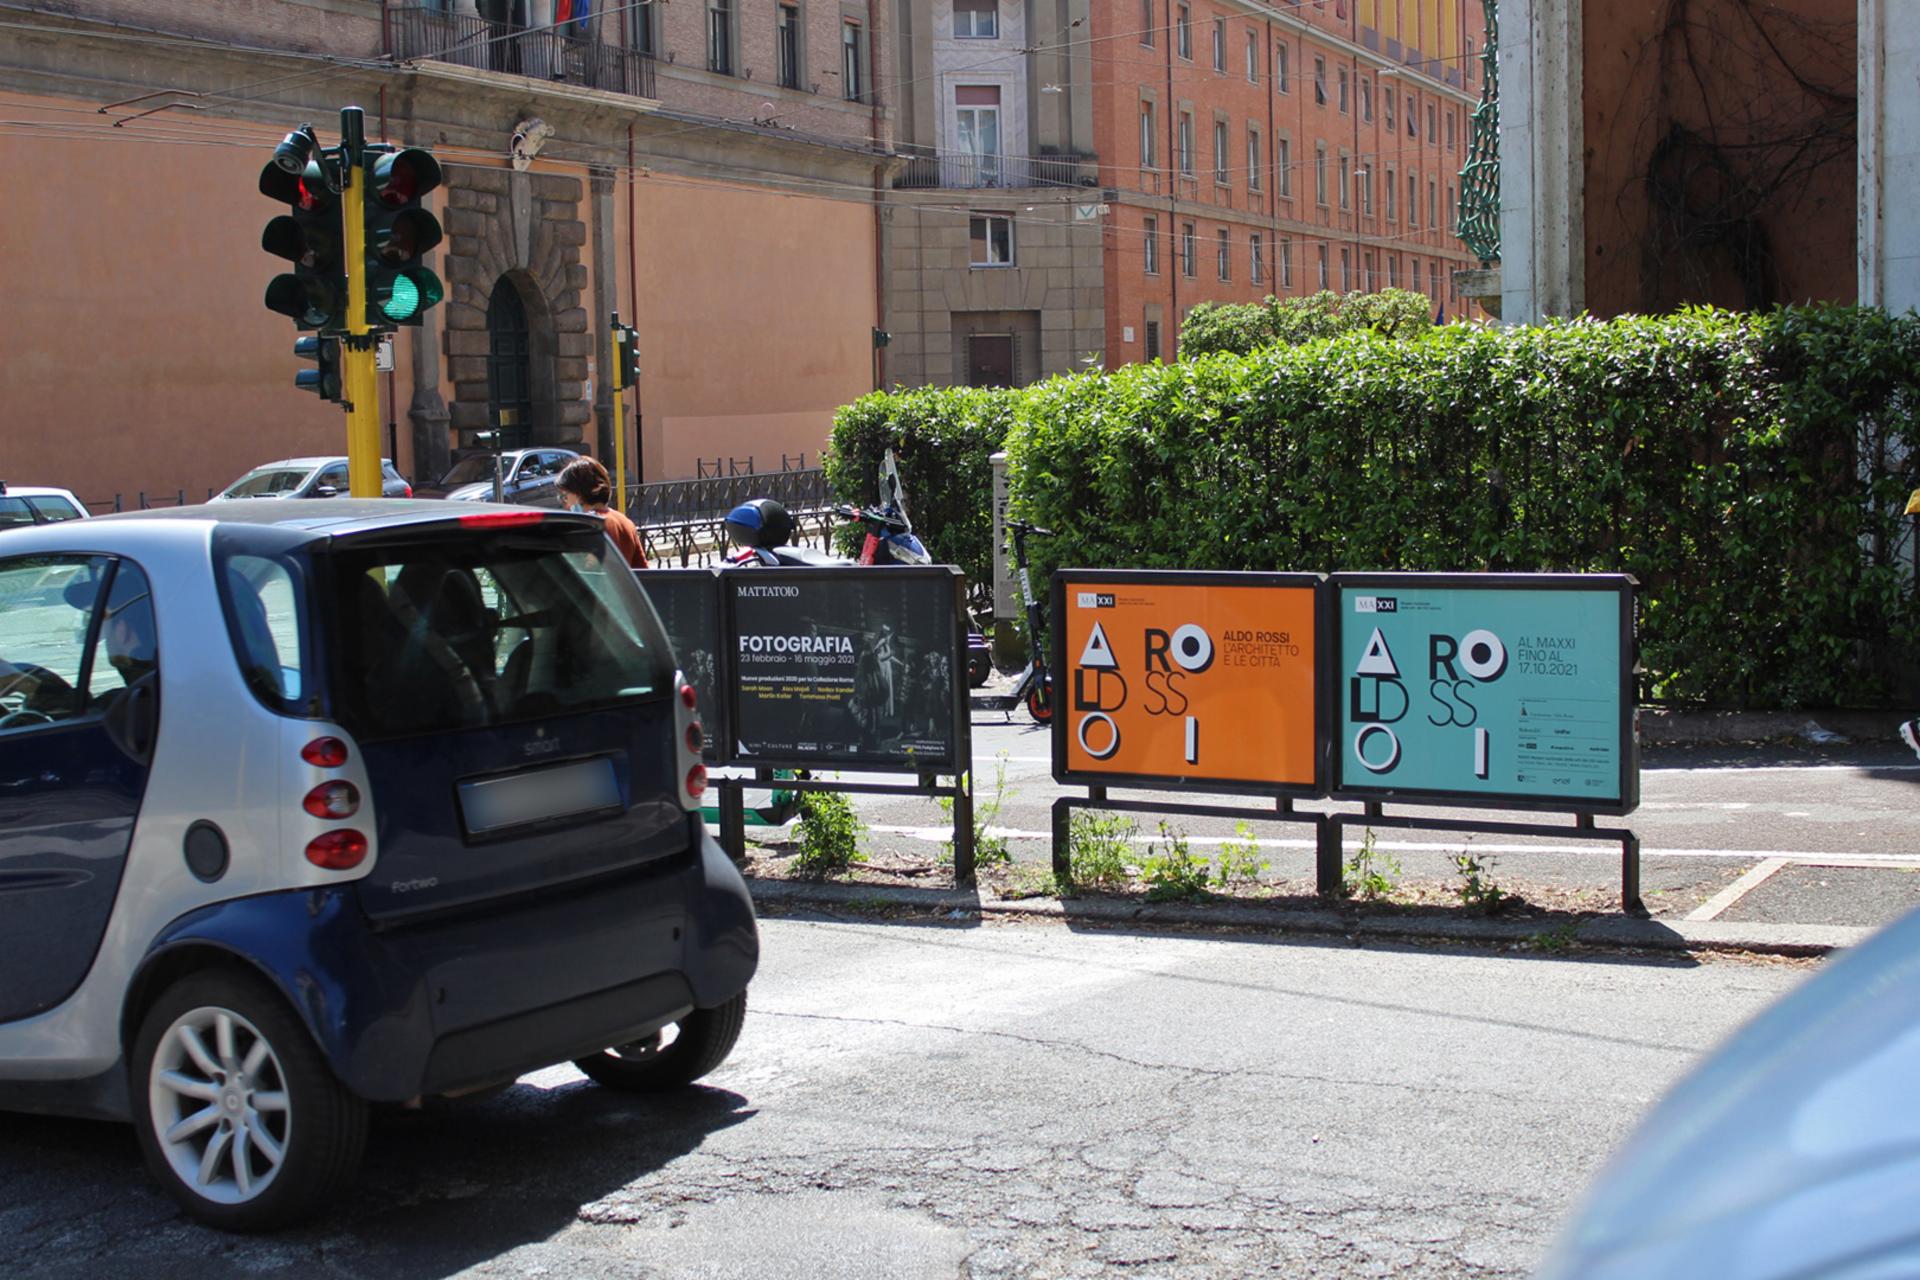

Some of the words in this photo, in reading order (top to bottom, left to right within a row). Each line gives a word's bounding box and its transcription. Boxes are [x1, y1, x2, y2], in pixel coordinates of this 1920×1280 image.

[738, 586, 799, 597] MATTATOIO
[1080, 595, 1114, 606] MAXXI
[1358, 599, 1395, 610] MAXXI
[1223, 630, 1253, 642] ALDO
[1256, 631, 1290, 643] ROSSI
[1518, 636, 1533, 648] AL
[1536, 637, 1576, 649] MAXXI
[739, 635, 854, 653] FOTOGRAFIA
[740, 654, 751, 663] 23
[752, 654, 787, 663] febbraio
[795, 654, 803, 663] 16
[804, 655, 836, 666] maggio
[837, 655, 855, 664] 2021
[1223, 654, 1231, 666] E
[1234, 654, 1247, 667] LE
[1518, 650, 1546, 661] FINO
[1549, 650, 1563, 662] AL
[1518, 662, 1578, 675] 17.10.2021
